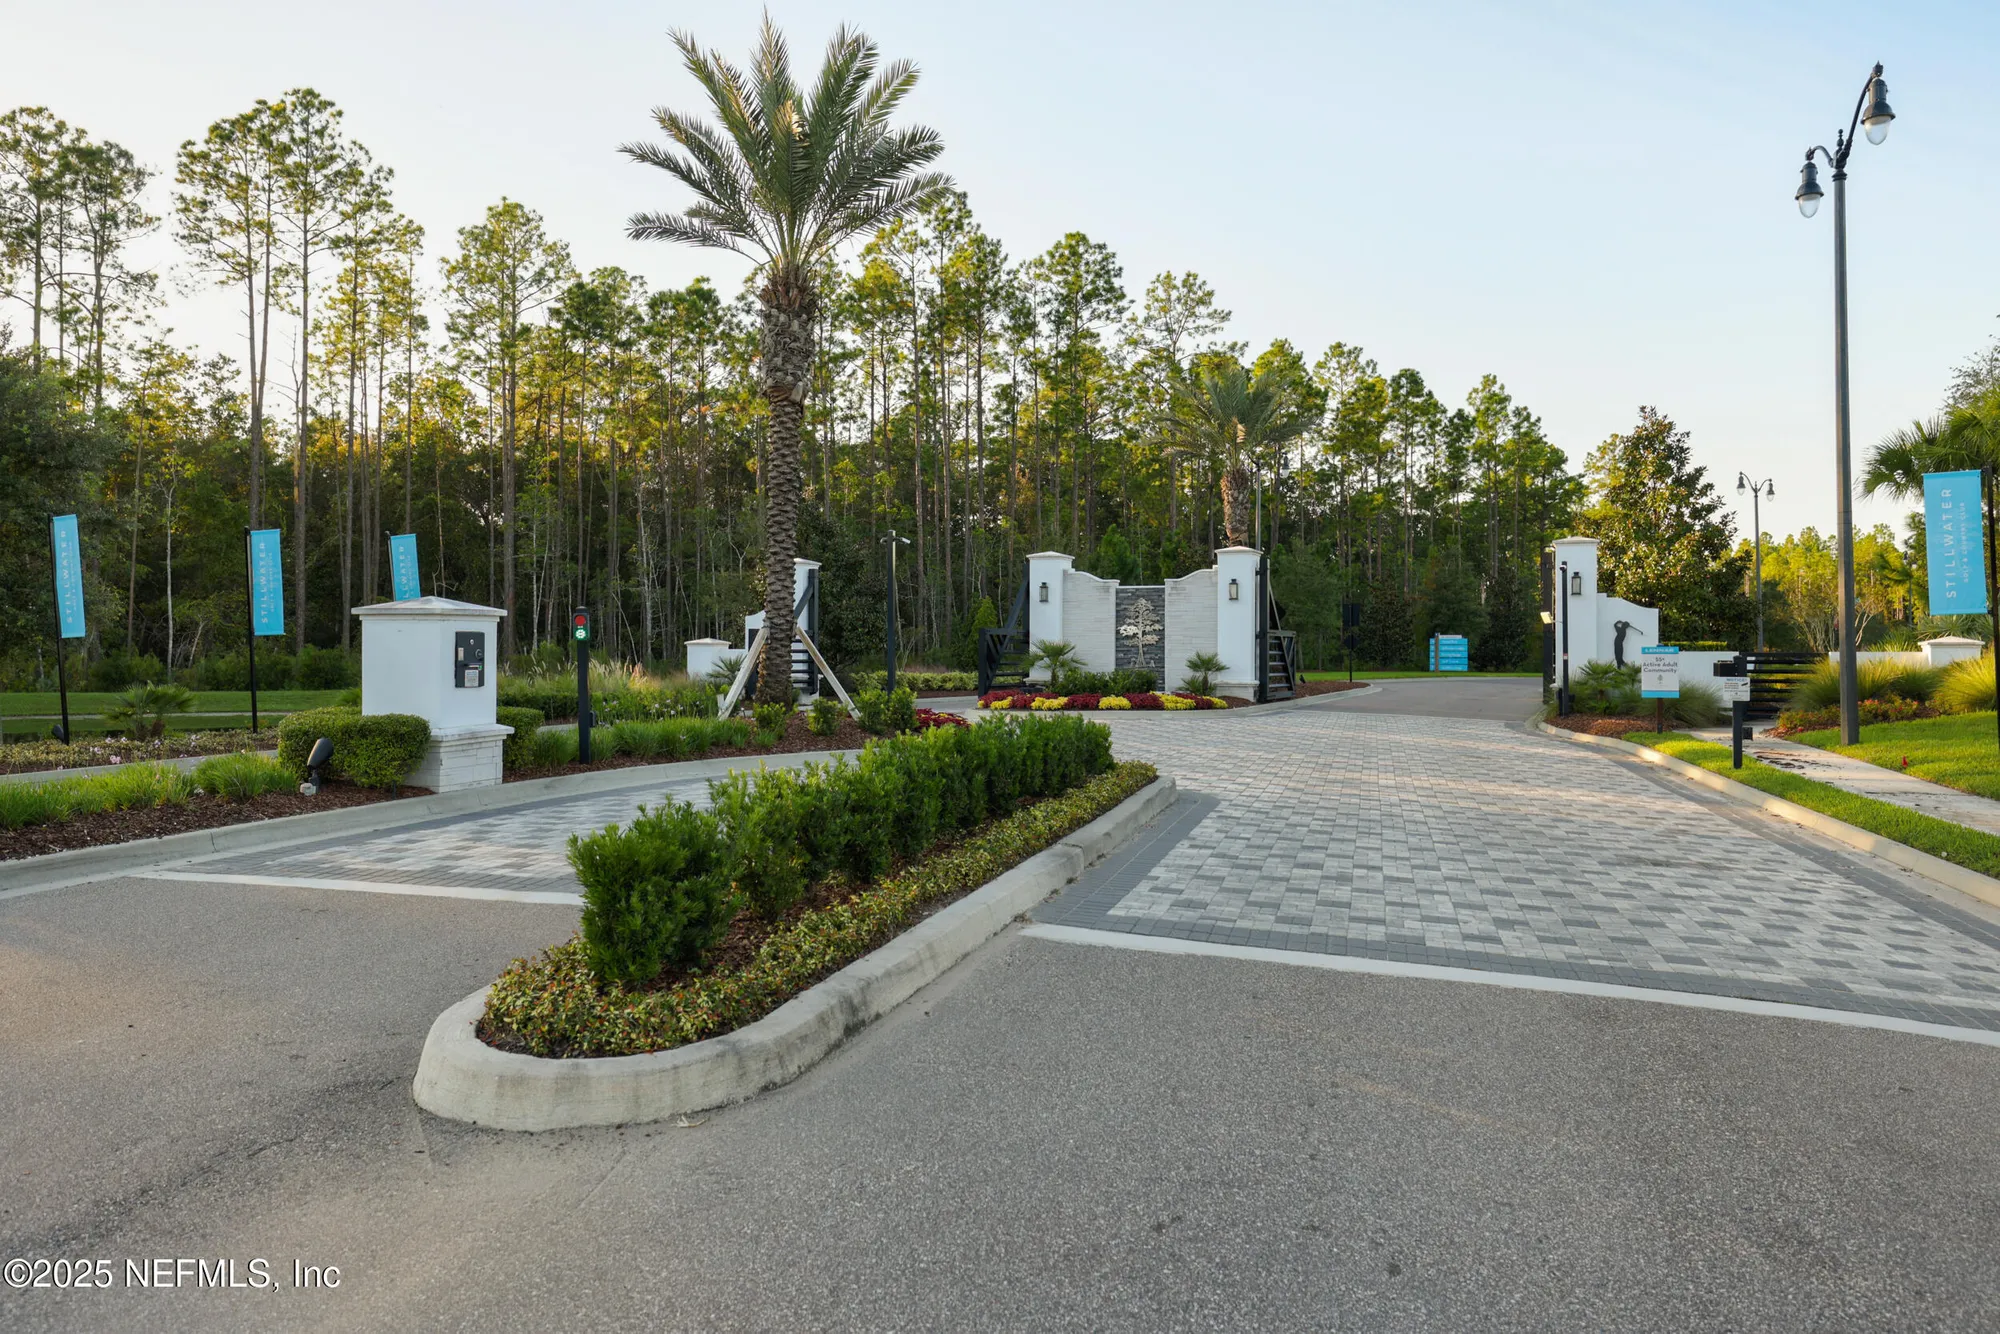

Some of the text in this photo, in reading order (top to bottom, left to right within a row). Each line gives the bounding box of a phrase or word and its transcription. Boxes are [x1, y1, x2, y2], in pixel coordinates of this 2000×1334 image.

[60, 530, 73, 623] STILLWATER
[259, 542, 269, 623] STILLWATER
[1941, 489, 1957, 598] STILLWATER
